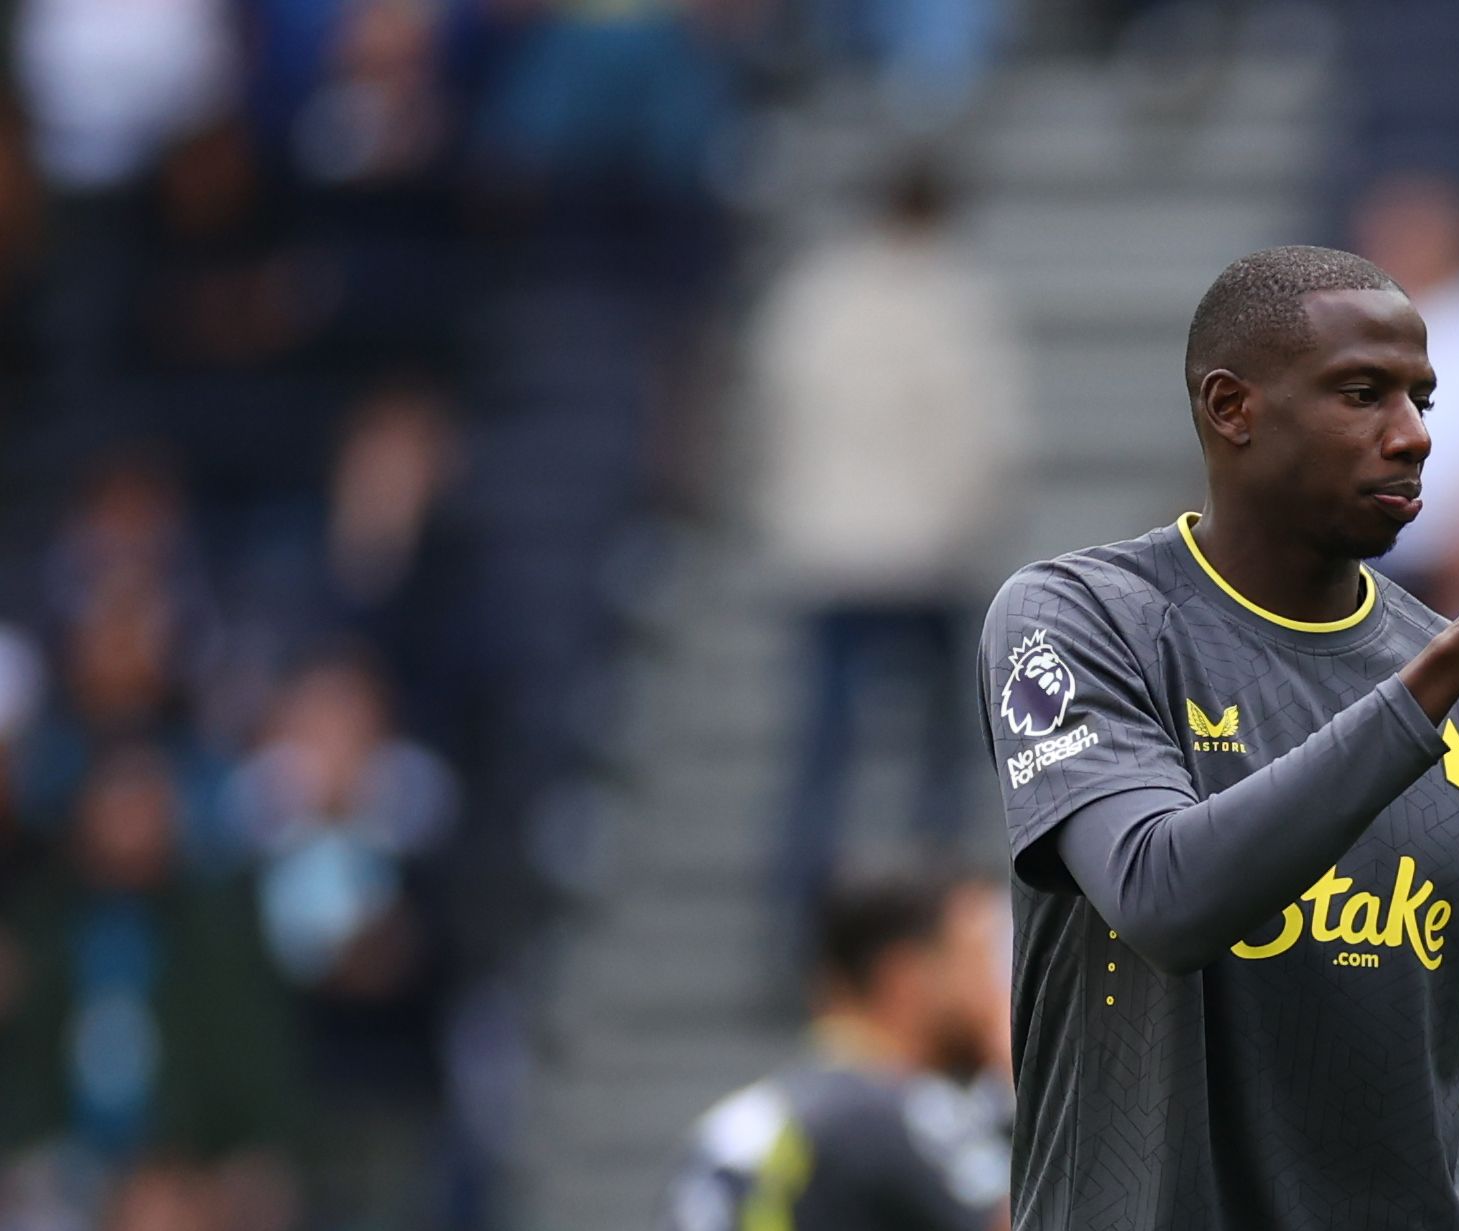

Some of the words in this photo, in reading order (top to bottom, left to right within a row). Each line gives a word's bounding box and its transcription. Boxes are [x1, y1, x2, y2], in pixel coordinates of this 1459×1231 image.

[1007, 749, 1034, 774] No
[1034, 724, 1089, 758] room
[1011, 762, 1035, 789] for
[1035, 732, 1099, 772] racism
[1333, 950, 1379, 968] .com
